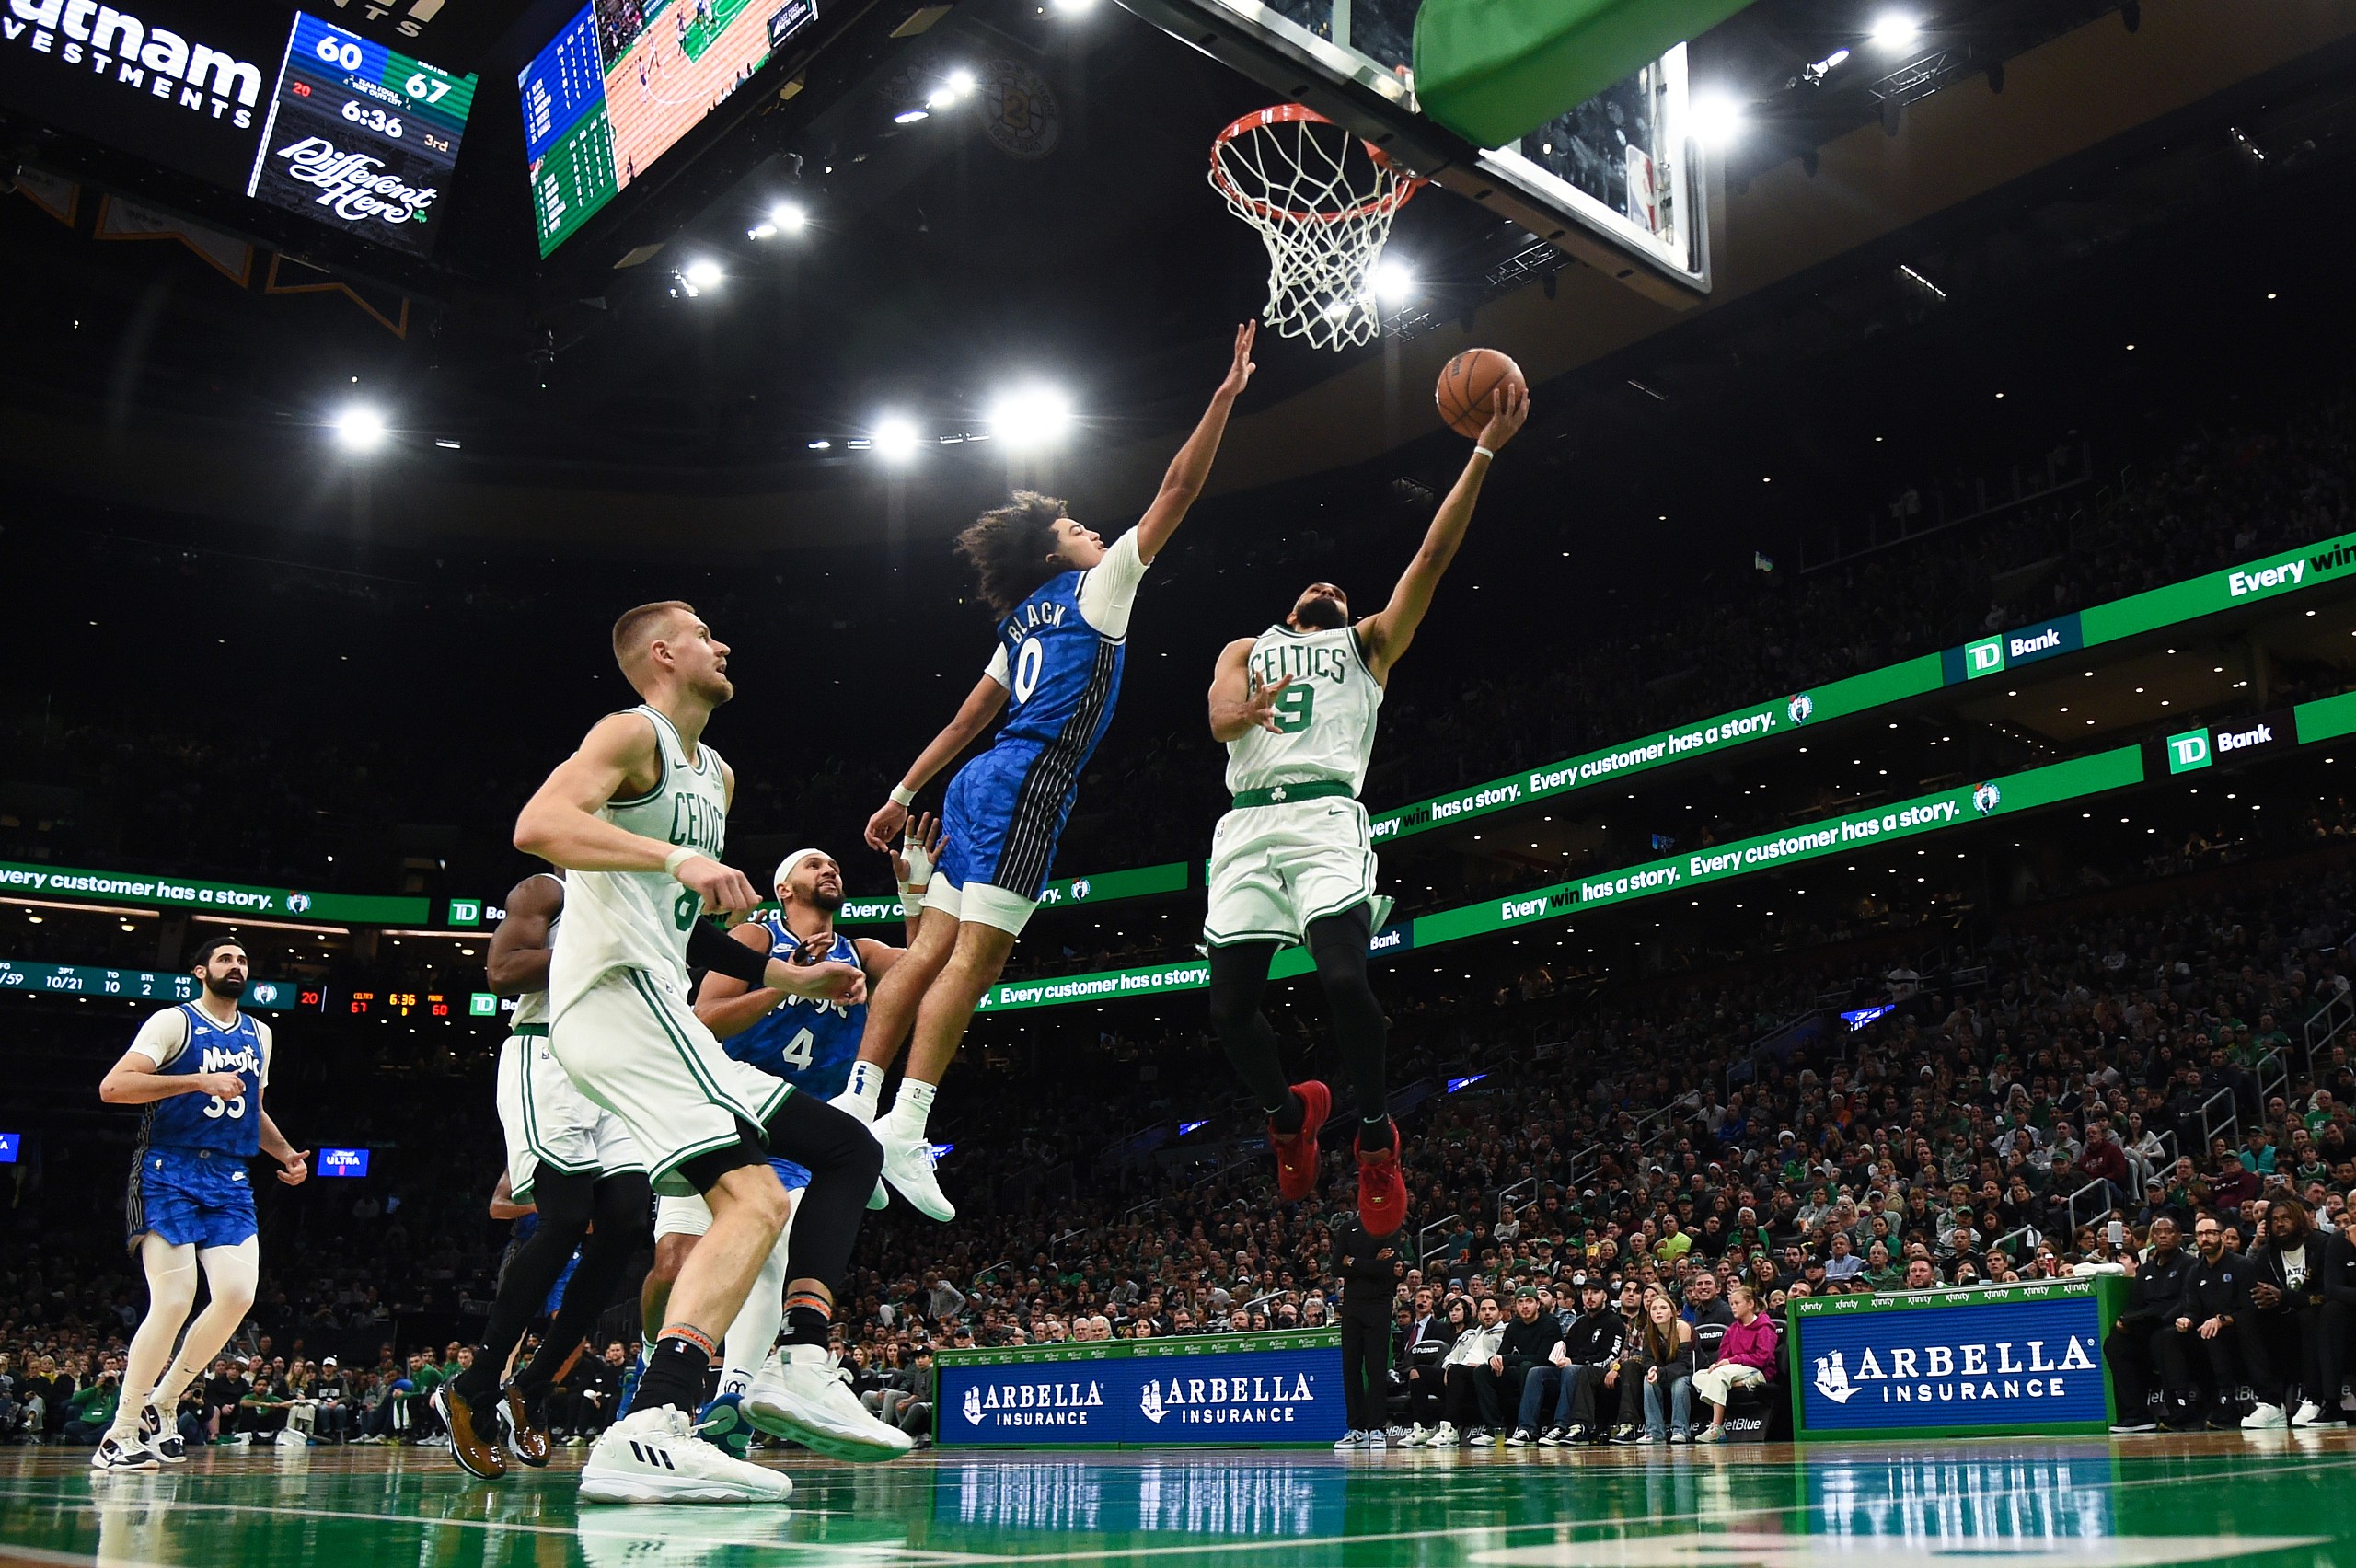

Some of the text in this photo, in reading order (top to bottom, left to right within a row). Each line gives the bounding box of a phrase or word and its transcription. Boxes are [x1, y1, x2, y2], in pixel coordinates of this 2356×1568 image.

[9, 0, 262, 108] utnam
[316, 35, 363, 71] 60
[293, 82, 311, 98] 20
[359, 78, 377, 89] TEAM
[405, 72, 451, 104] 67
[341, 100, 403, 138] 6:36
[424, 134, 449, 154] 3rd
[277, 137, 437, 208] Different
[289, 164, 413, 224] Here
[2229, 559, 2304, 597] Every
[1008, 602, 1066, 644] BLACK
[1969, 628, 2061, 670] TD Bank
[1015, 637, 1043, 705] 0
[1251, 645, 1346, 690] CELTICS
[1274, 684, 1315, 733] 9
[2171, 724, 2273, 764] TD Bank
[1403, 807, 1430, 828] win
[1432, 802, 1461, 820] has
[1463, 797, 1474, 812] a
[1475, 784, 1521, 808] story.
[1530, 767, 1578, 792] Every
[1580, 742, 1666, 779] customer
[1668, 730, 1703, 755] has
[1705, 727, 1718, 743] a
[1721, 711, 1777, 739] story.
[1502, 801, 1960, 920] Every win has a story. Every customer has a story.
[50, 873, 155, 895] customer
[156, 882, 197, 900] has
[199, 887, 214, 902] a
[215, 889, 274, 910] story.
[452, 903, 478, 920] TD
[841, 903, 891, 918] Every
[1370, 930, 1400, 950] Bank
[46, 976, 83, 991] 10/21
[104, 980, 121, 993] 10
[142, 984, 152, 996] 2
[175, 986, 191, 998] 13
[58, 967, 74, 975] 3PT
[107, 971, 119, 979] TO
[140, 974, 155, 982] STL
[175, 977, 191, 986] AST
[1001, 987, 1043, 1004] Every
[1045, 976, 1118, 998] customer
[1121, 973, 1149, 990] has
[1151, 974, 1162, 986] a
[1165, 968, 1211, 985] story.
[301, 992, 318, 1004] 20
[351, 1002, 367, 1013] 67
[433, 1005, 447, 1016] 60
[389, 994, 416, 1006] 6:36
[474, 997, 494, 1011] TD
[783, 1027, 814, 1071] 4
[327, 1156, 360, 1166] ULTRA
[1800, 1302, 1823, 1312] xfinity
[1835, 1299, 1858, 1310] xfinity
[1854, 1334, 2096, 1379] ARBELLA
[983, 1380, 1103, 1409] ARBELLA
[1164, 1372, 1313, 1404] ARBELLA
[1883, 1378, 2065, 1402] INSURANCE
[997, 1412, 1088, 1425] INSURANCE
[1182, 1407, 1294, 1424] INSURANCE
